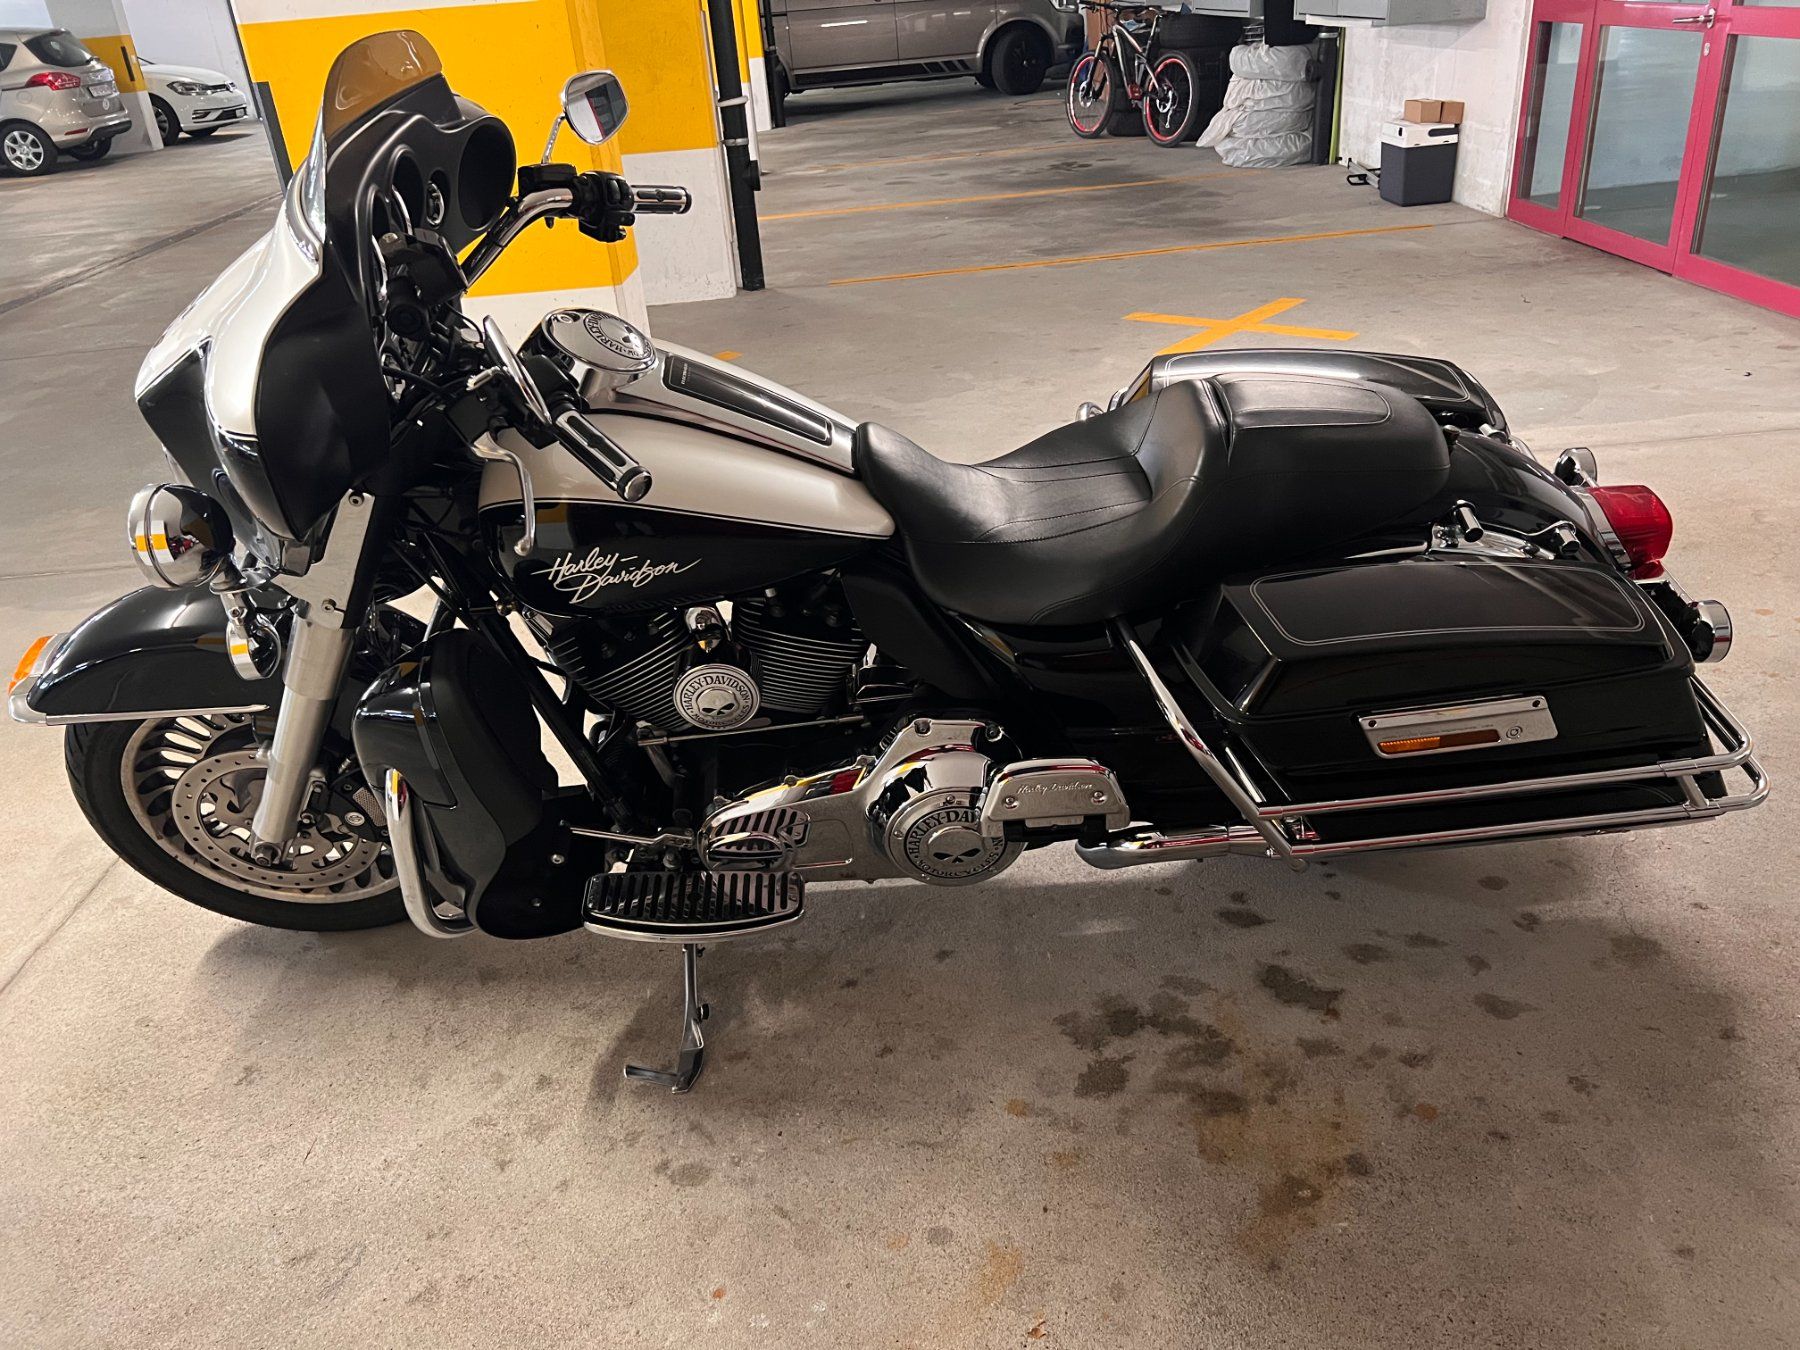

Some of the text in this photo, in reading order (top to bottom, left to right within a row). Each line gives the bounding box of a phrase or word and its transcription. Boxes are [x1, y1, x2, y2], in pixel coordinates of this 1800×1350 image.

[530, 547, 638, 584] Harley-
[553, 558, 702, 604] Davidson
[683, 675, 751, 711] HARLEY-DAVIDSON
